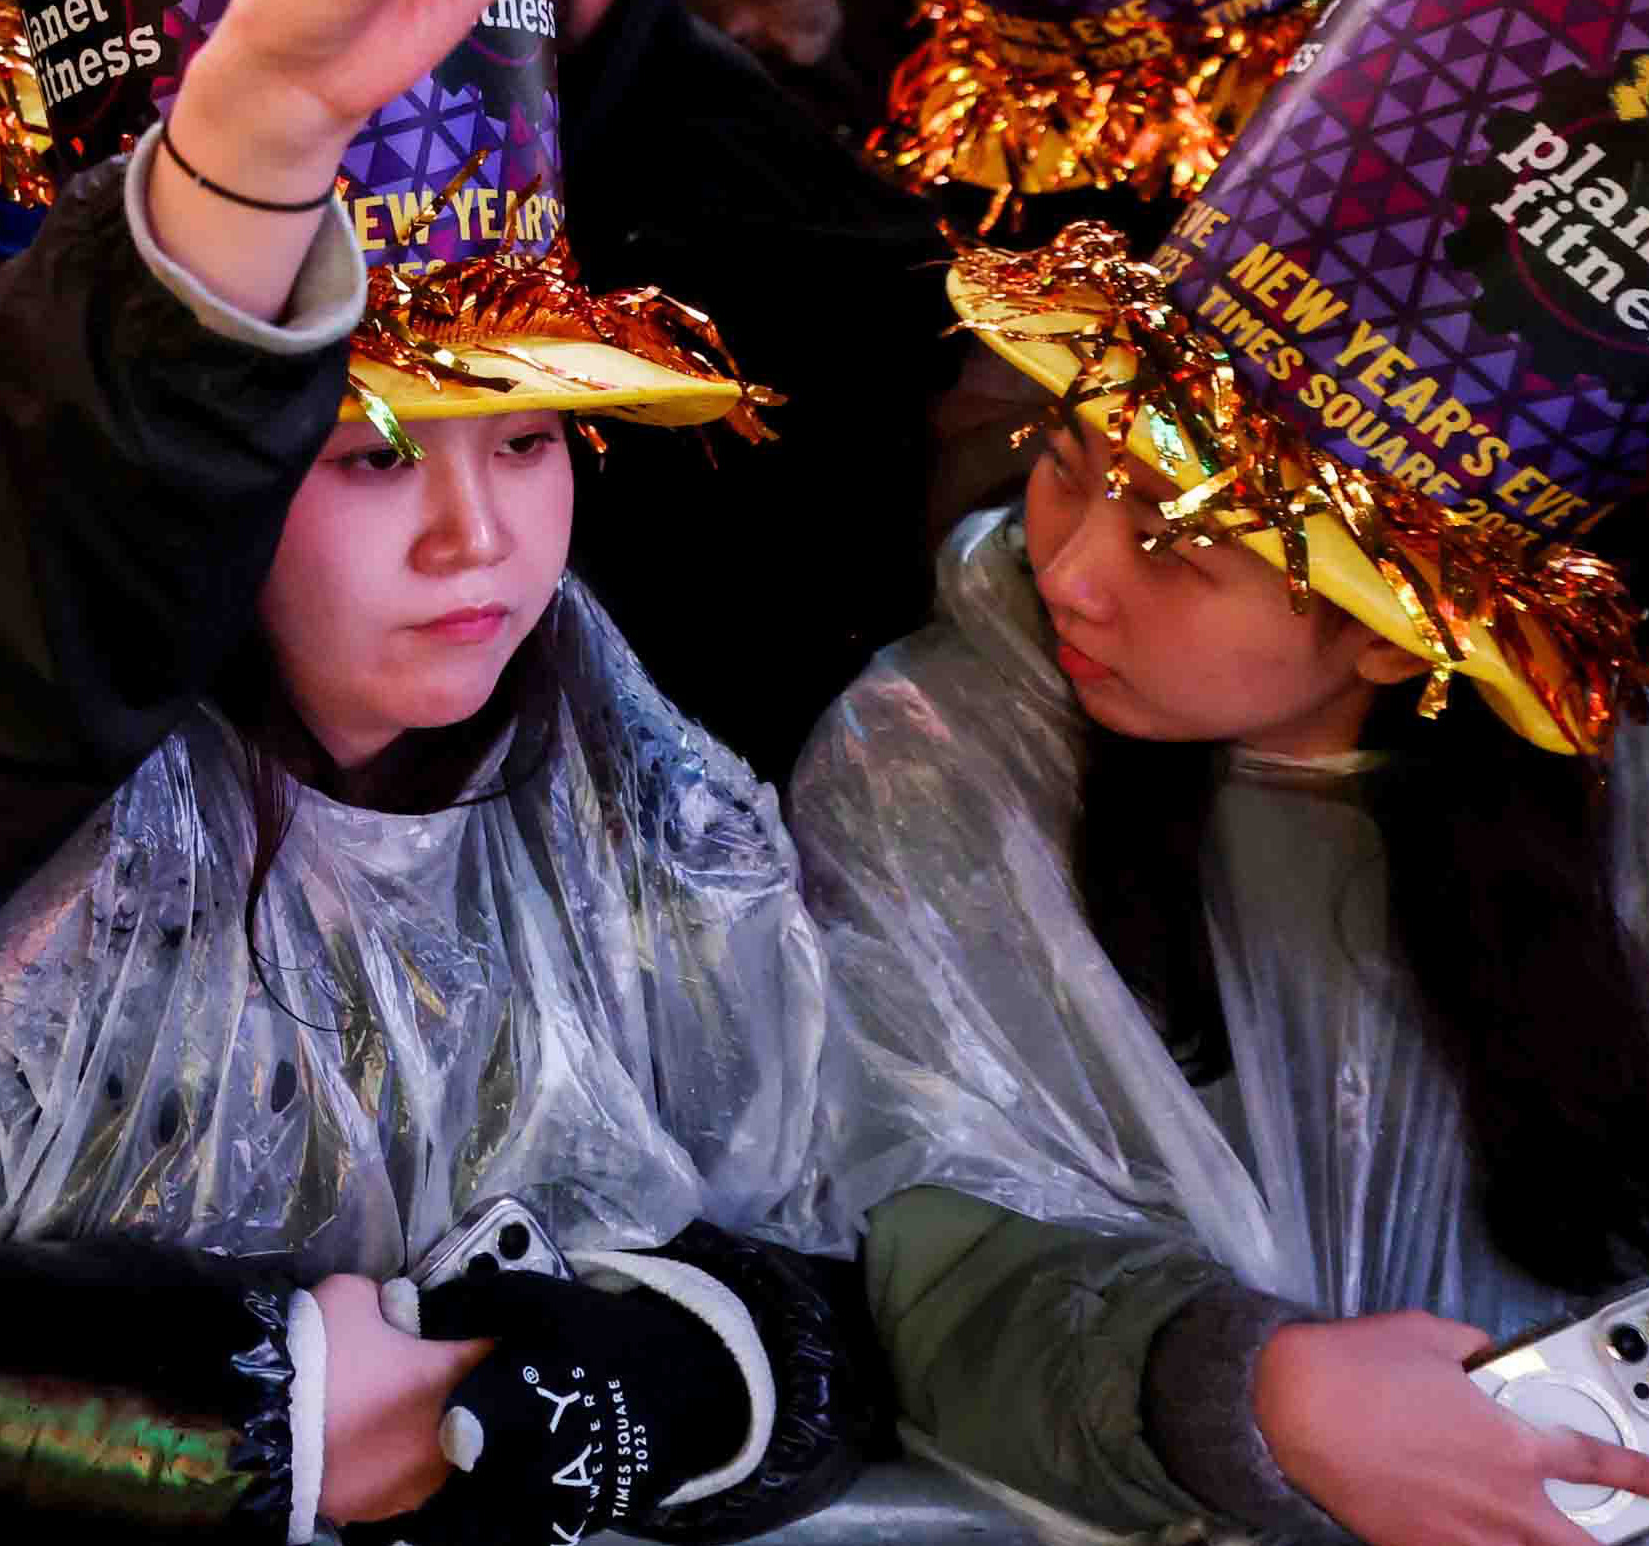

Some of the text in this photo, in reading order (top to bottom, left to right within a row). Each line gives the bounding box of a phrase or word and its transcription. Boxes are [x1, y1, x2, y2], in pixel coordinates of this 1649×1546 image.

[34, 23, 162, 111] itness
[342, 189, 433, 251] EW
[1490, 179, 1649, 334] fitne
[1497, 122, 1649, 263] plan
[1197, 285, 1304, 381] TIMES
[1298, 373, 1463, 499] SQUARE
[1229, 242, 1589, 525] NEW YEAR'S EVE
[536, 1386, 593, 1546] KAY
[571, 1366, 603, 1514] WELERS
[608, 1379, 632, 1518] TIMES SQUARE
[633, 1424, 649, 1473] 2023
